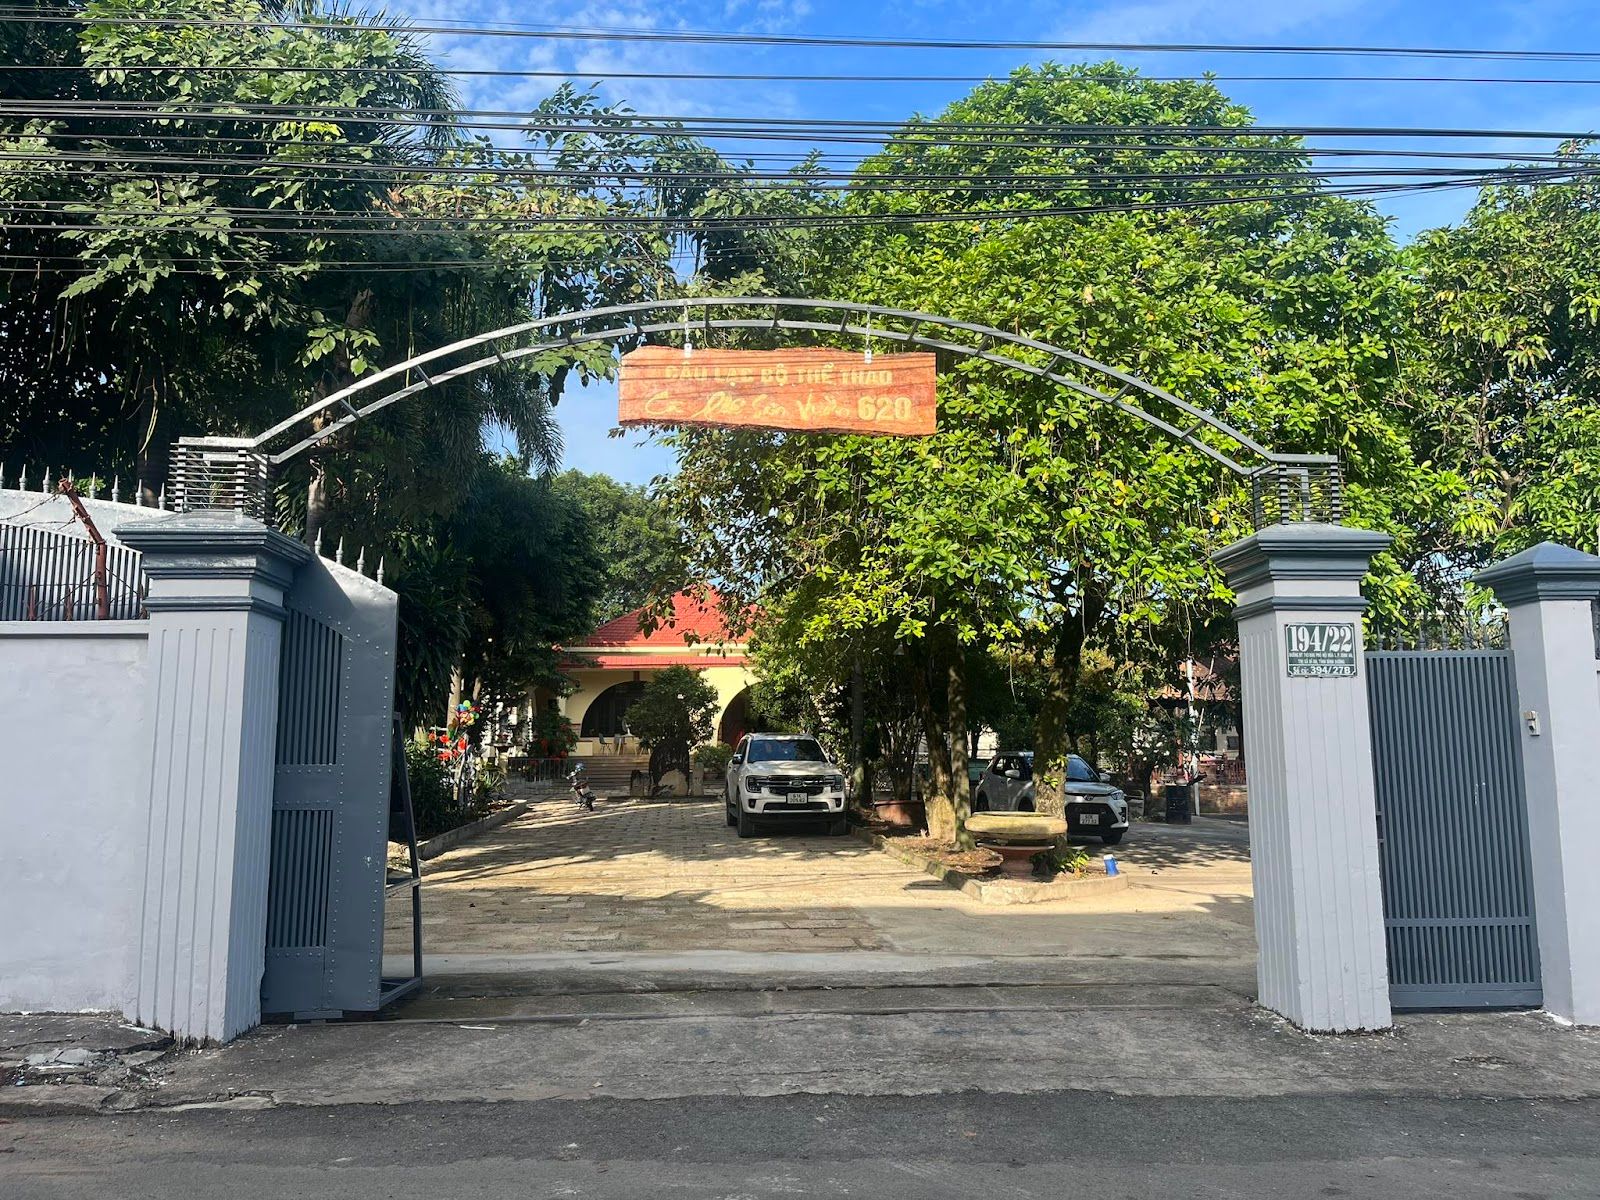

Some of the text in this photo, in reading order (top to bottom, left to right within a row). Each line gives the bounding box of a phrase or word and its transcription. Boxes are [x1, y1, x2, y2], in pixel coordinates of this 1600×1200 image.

[760, 363, 788, 387] BỘ
[797, 361, 836, 386] THỂ
[840, 368, 893, 386] THAO
[857, 395, 912, 421] 620
[1290, 626, 1352, 652] 194/22
